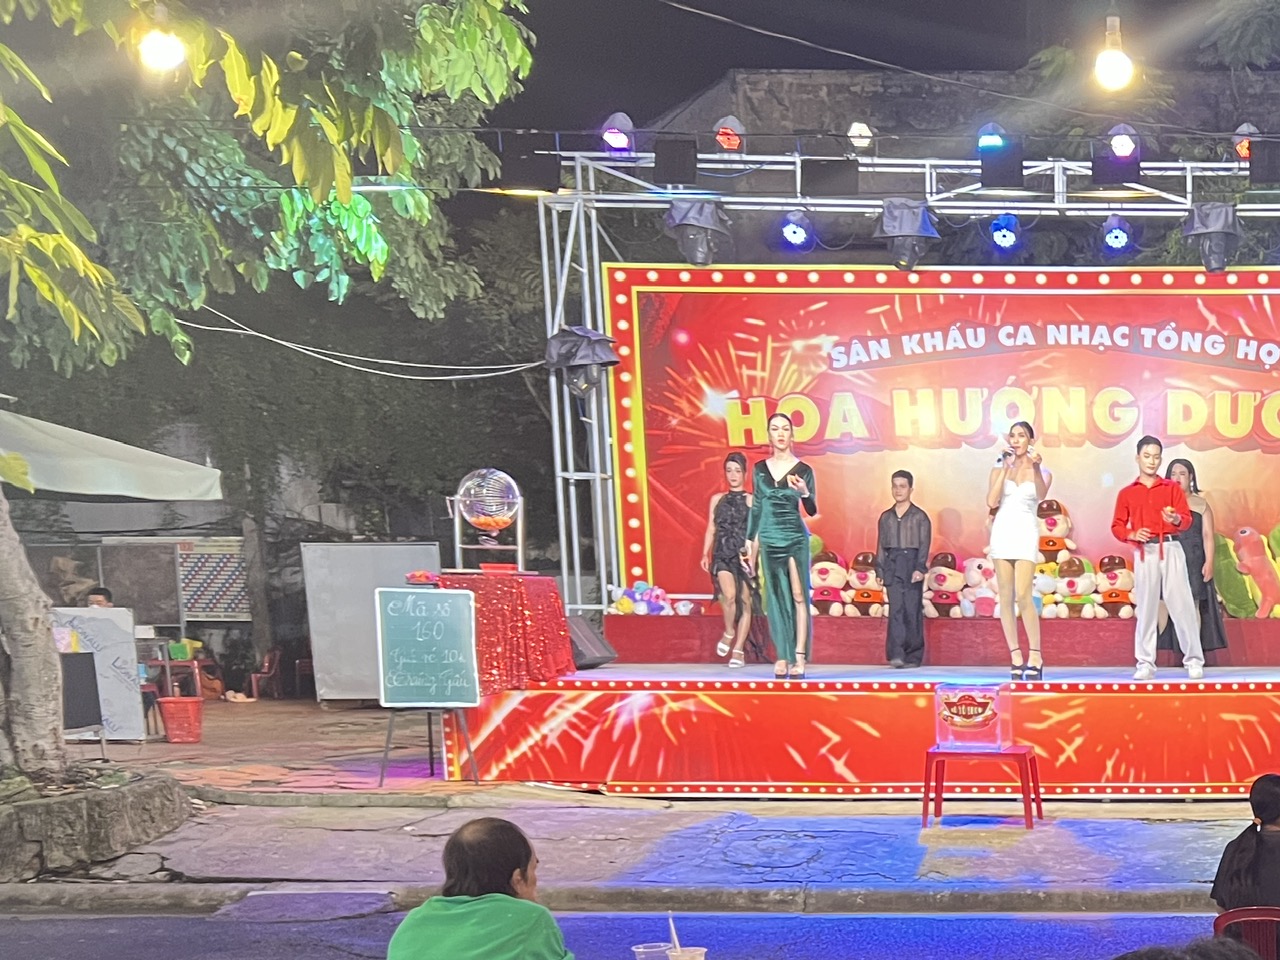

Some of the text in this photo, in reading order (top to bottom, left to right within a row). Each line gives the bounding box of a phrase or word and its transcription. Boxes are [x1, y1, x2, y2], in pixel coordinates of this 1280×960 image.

[830, 339, 892, 369] SÂN
[901, 322, 986, 356] KHẤU
[997, 324, 1037, 347] CA
[1046, 324, 1129, 351] NHẠC
[1140, 321, 1226, 356] TỔNG
[724, 390, 870, 447] HOA
[892, 375, 1140, 437] HƯỚNG
[411, 621, 445, 641] 160
